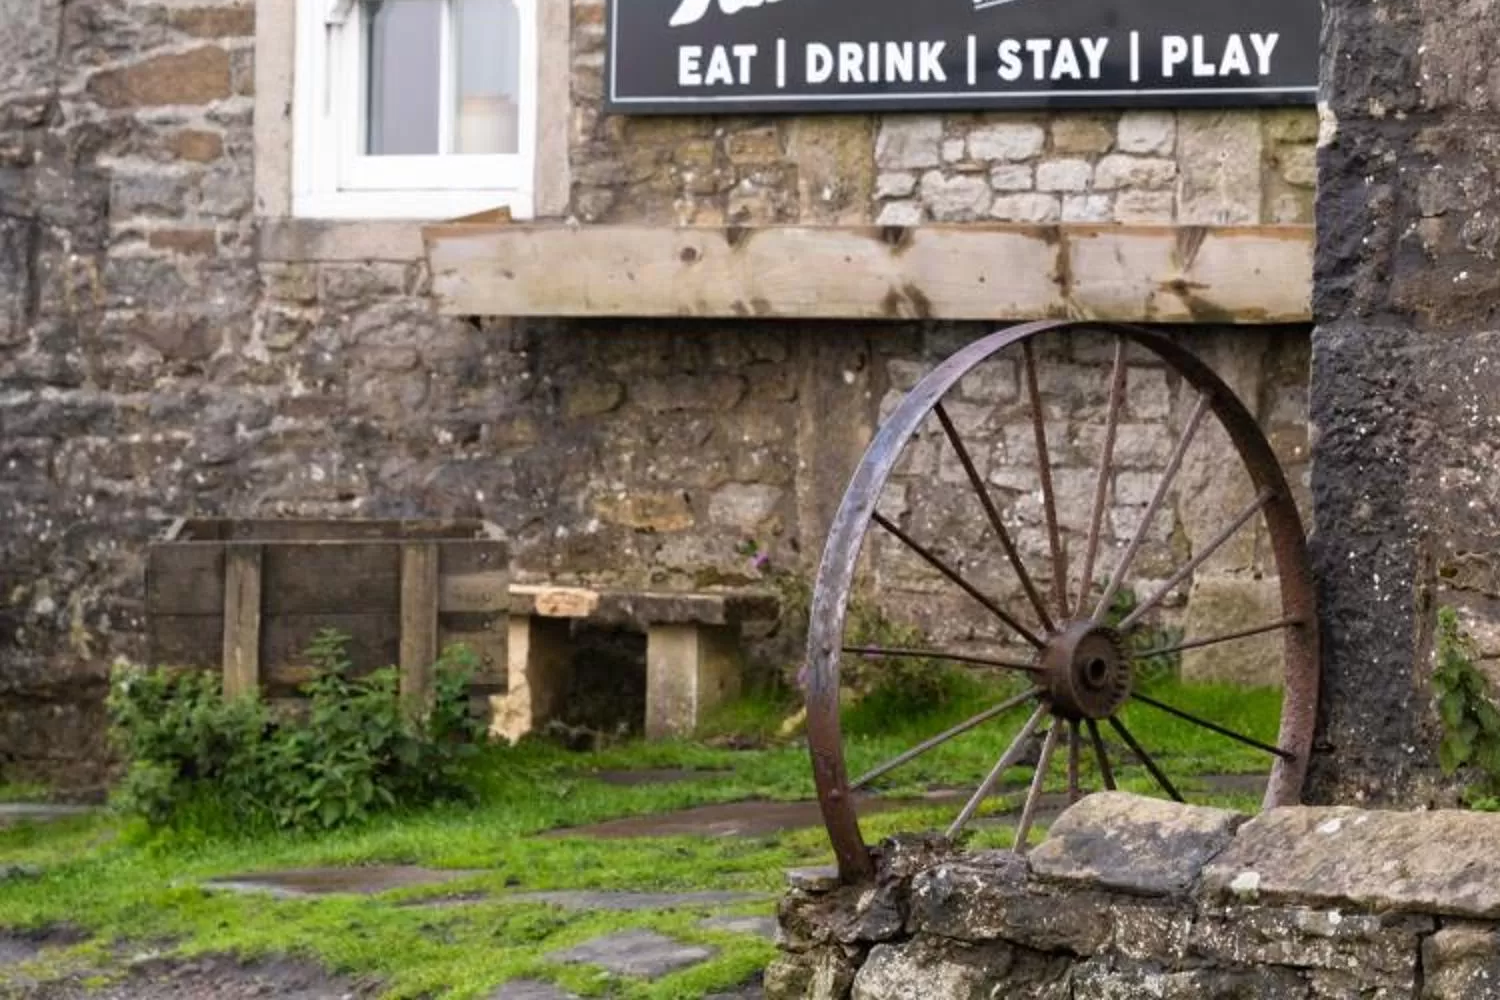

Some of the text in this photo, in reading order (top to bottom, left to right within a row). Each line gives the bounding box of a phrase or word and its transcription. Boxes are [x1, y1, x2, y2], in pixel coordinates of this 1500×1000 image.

[678, 33, 1279, 86] EAT DRINK STAY PLAY
